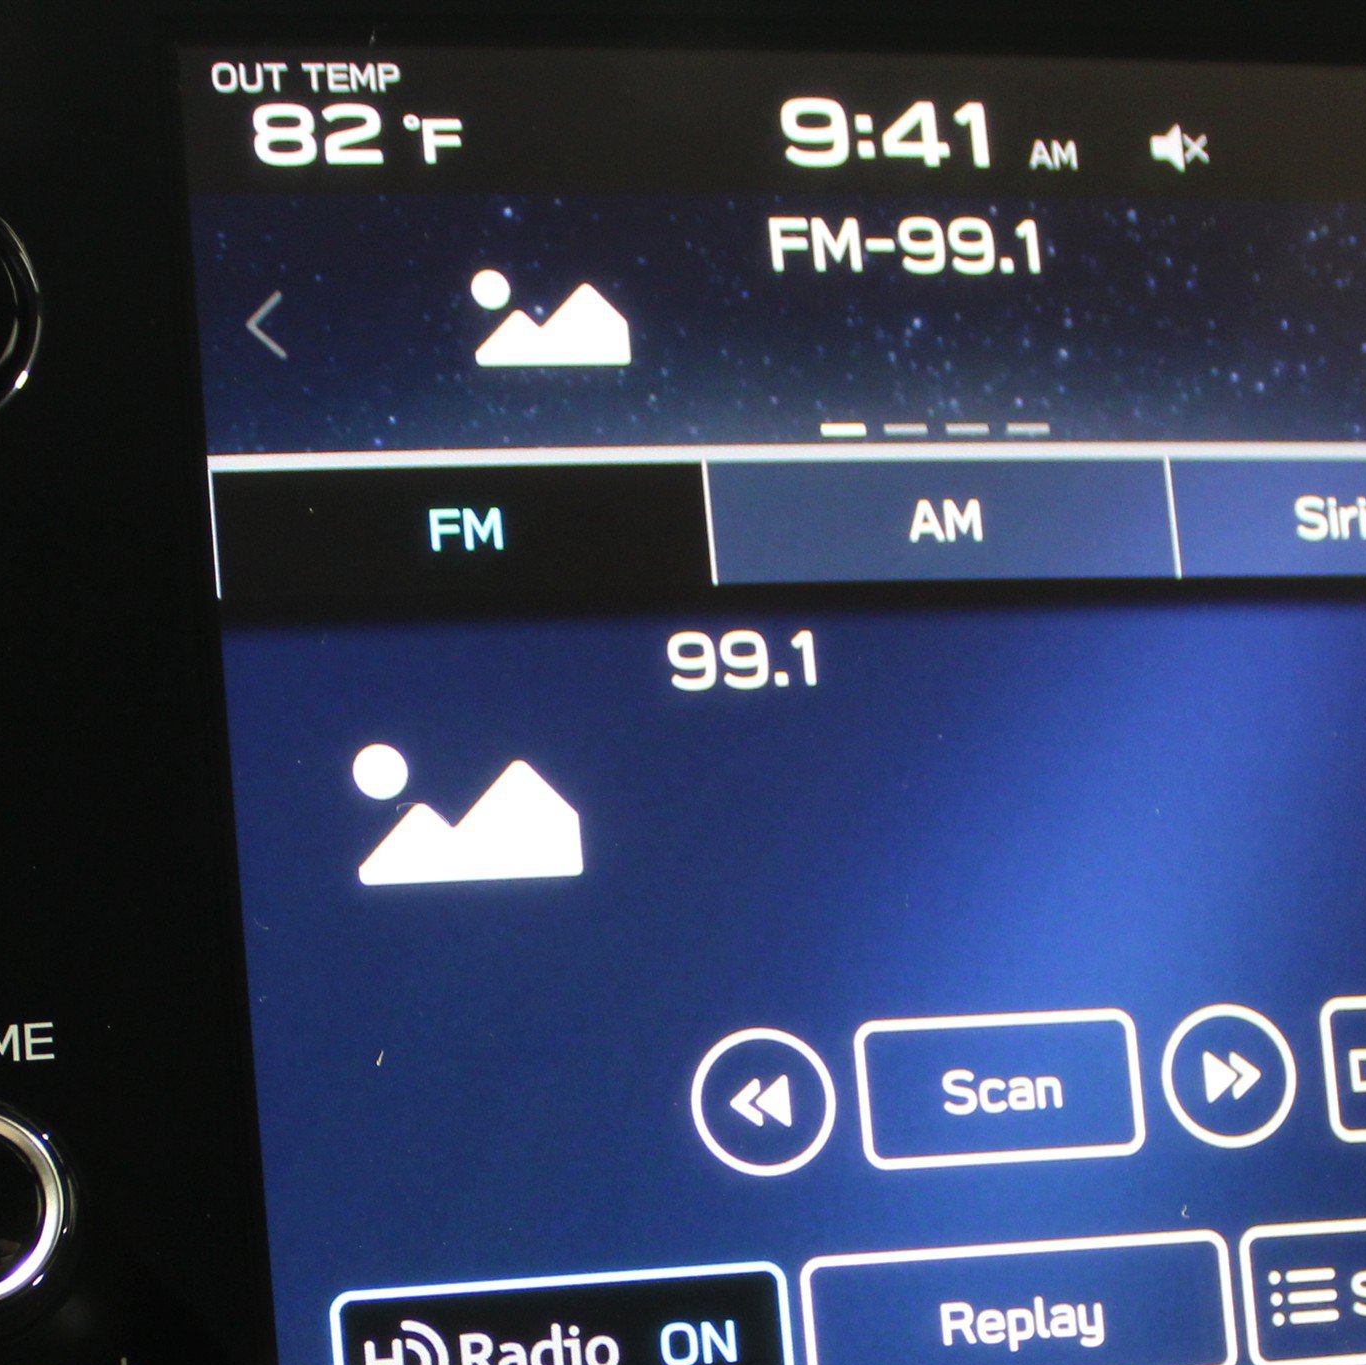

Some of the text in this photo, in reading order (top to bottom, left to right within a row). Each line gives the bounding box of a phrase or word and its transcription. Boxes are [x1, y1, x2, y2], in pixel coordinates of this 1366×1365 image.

[210, 61, 401, 94] OUT TEMP
[251, 102, 385, 168] 82
[779, 96, 1080, 171] 9:41 AM
[768, 215, 1042, 276] FM-99.1
[427, 507, 505, 554] FM
[908, 499, 985, 544] AM
[666, 630, 820, 692] 99.1
[941, 1068, 1065, 1117] Scan
[939, 1298, 1106, 1353] Replay
